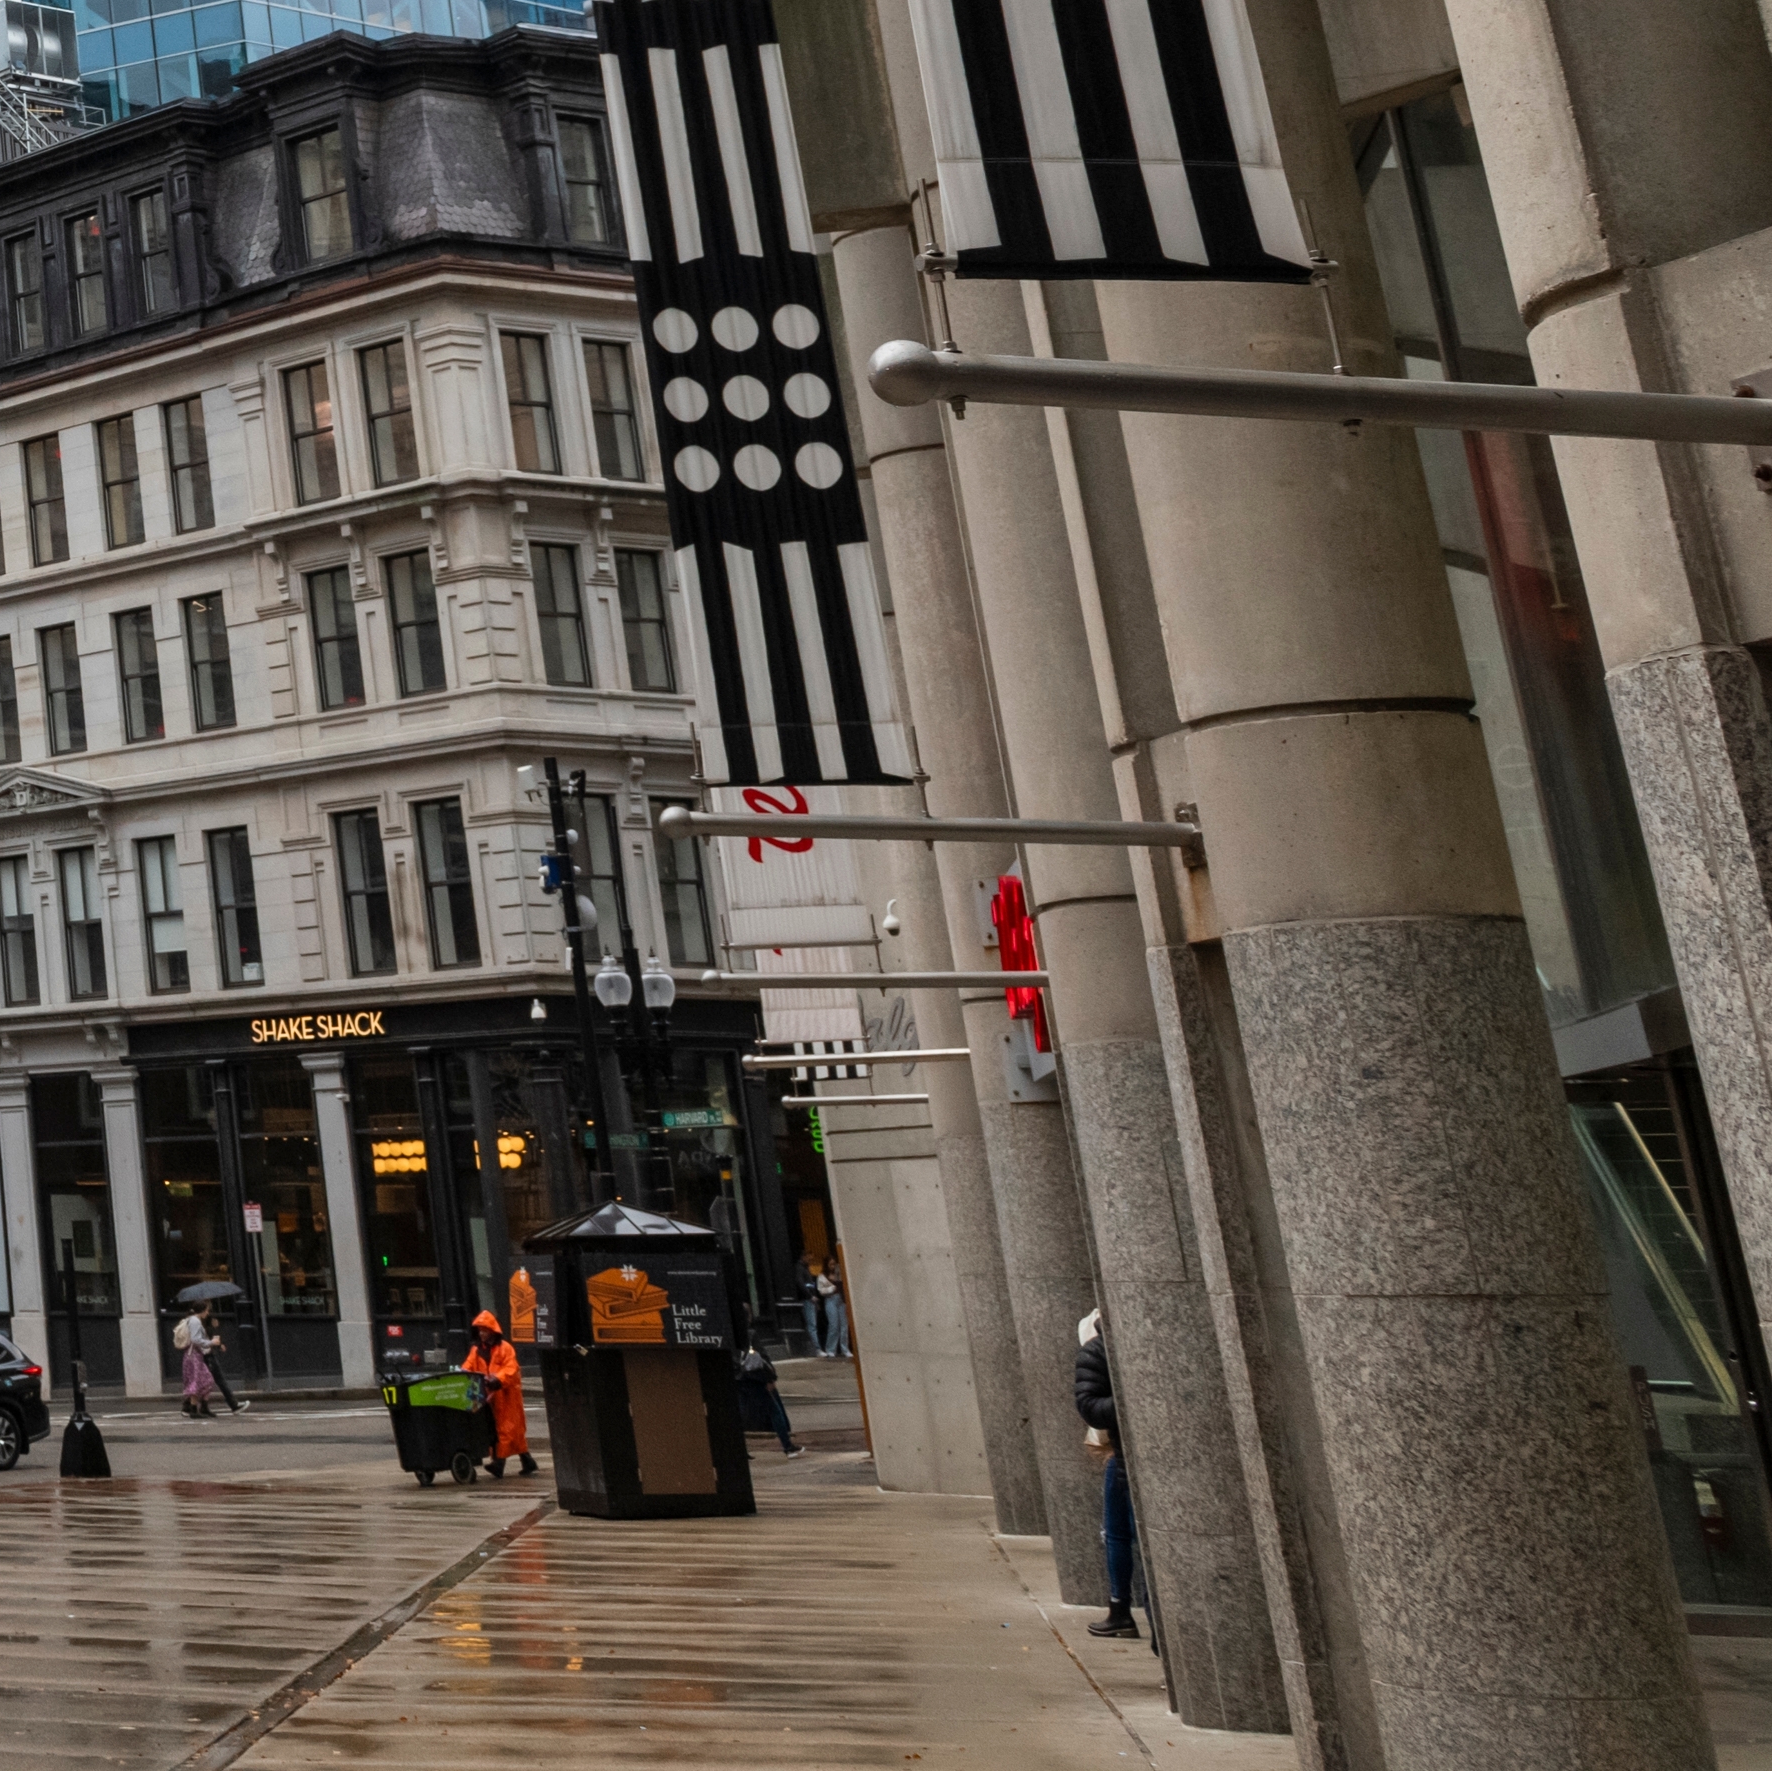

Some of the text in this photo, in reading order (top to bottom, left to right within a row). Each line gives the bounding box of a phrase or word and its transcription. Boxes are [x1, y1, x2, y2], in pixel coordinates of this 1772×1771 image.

[251, 1011, 385, 1043] SHAKE SHACK
[672, 1304, 707, 1317] Little
[674, 1318, 702, 1330] Free
[676, 1332, 723, 1348] Library
[382, 1387, 397, 1405] 17
[1635, 1381, 1656, 1430] PUSH
